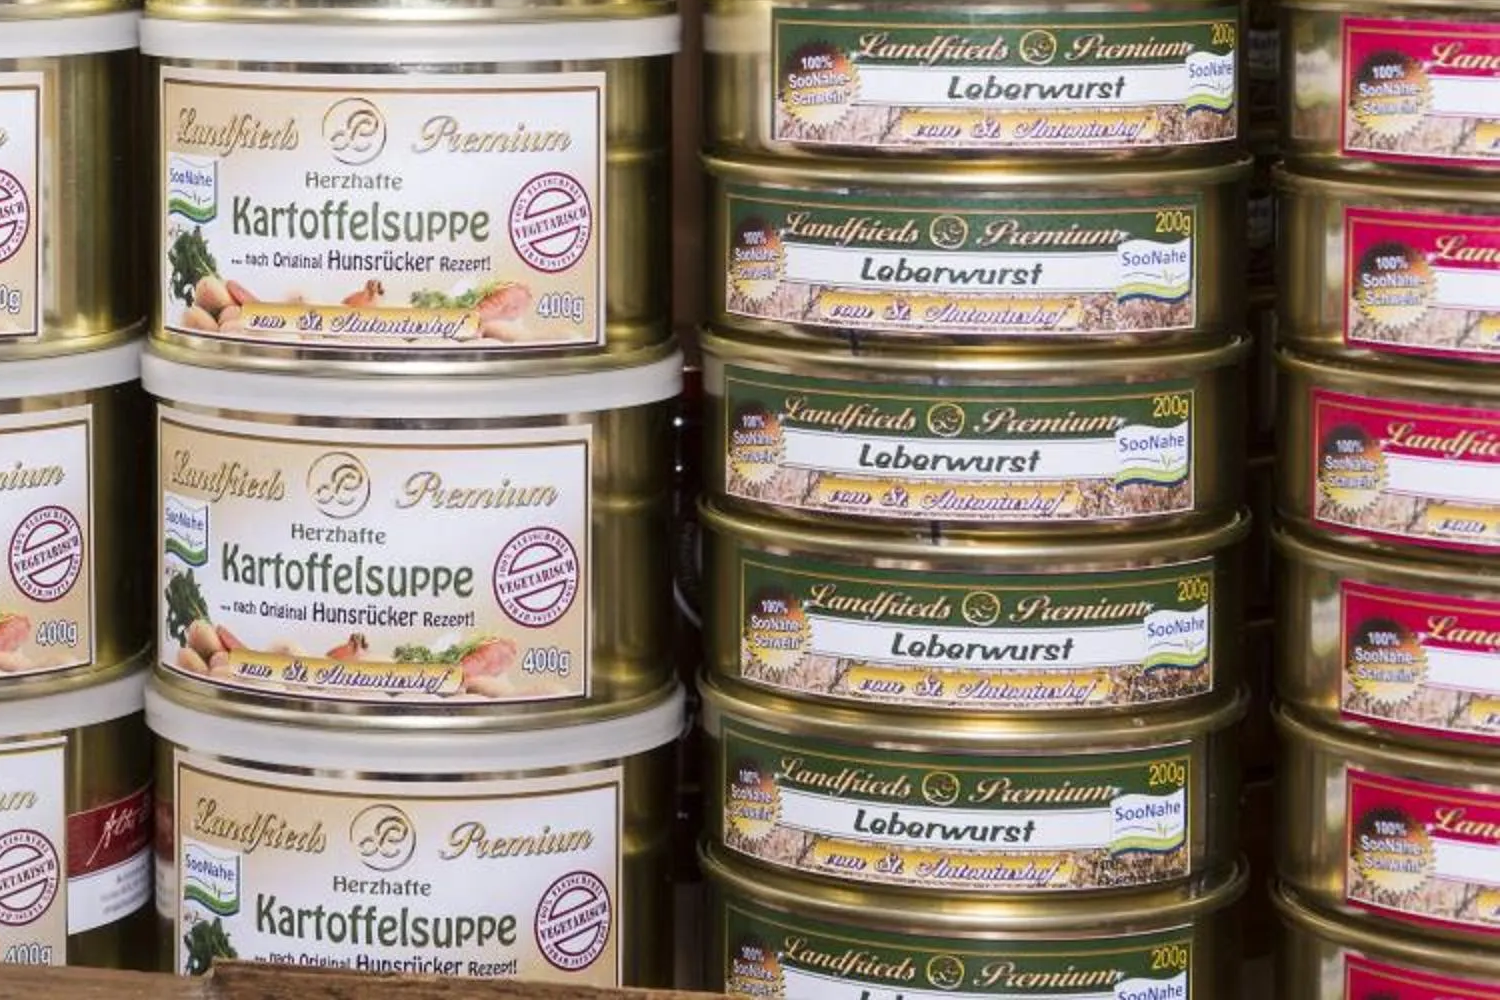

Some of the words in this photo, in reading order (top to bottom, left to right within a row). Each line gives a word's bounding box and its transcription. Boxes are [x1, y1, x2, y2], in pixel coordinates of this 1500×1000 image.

[1064, 33, 1193, 61] Premium
[1211, 24, 1234, 48] 200g
[801, 56, 833, 72] 100%
[1188, 61, 1232, 79] SooNahe
[948, 75, 1127, 100] Leberwurst
[412, 115, 573, 155] Premium
[305, 171, 403, 191] Herzhafte
[233, 196, 490, 243] Kartoffelsuppe
[515, 206, 588, 239] VEGETARISCH
[975, 219, 1124, 248] Premium
[1155, 210, 1192, 235] 200g
[327, 249, 435, 273] Hunsrücker
[440, 255, 492, 273] Rezept!
[861, 257, 1043, 286] Leberwurst
[1122, 249, 1187, 267] SooNahe
[536, 292, 587, 323] 400g
[973, 406, 1121, 435] Premium
[1152, 395, 1189, 419] 200g
[859, 443, 1042, 473] Leberwurst
[1119, 434, 1186, 454] SooNahe
[396, 470, 560, 510] Premium
[292, 522, 387, 546] Herzhafte
[221, 541, 474, 597] Kartoffelsuppe
[498, 559, 575, 595] VEGETARISCH
[1177, 580, 1209, 604] 200g
[260, 602, 308, 621] Original
[311, 603, 419, 628] Hunsrücker
[422, 611, 476, 628] Rezept!
[1010, 595, 1151, 623] Premium
[35, 619, 78, 648] 400g
[1148, 618, 1205, 638] SooNahe
[892, 632, 1074, 661] Leberwurst
[522, 646, 572, 677] 400g
[1149, 763, 1186, 788] 200g
[968, 778, 1114, 804] Premium
[1115, 800, 1181, 822] SooNahe
[854, 808, 1036, 843] Leberwurst
[439, 821, 594, 860] Premium
[184, 853, 235, 882] SooNahe
[333, 875, 432, 898] Herzhafte
[255, 894, 517, 949] Kartoffelsuppe
[1152, 946, 1187, 972] 200g
[973, 961, 1122, 989] Premium
[1118, 984, 1184, 1000] SooNahe
